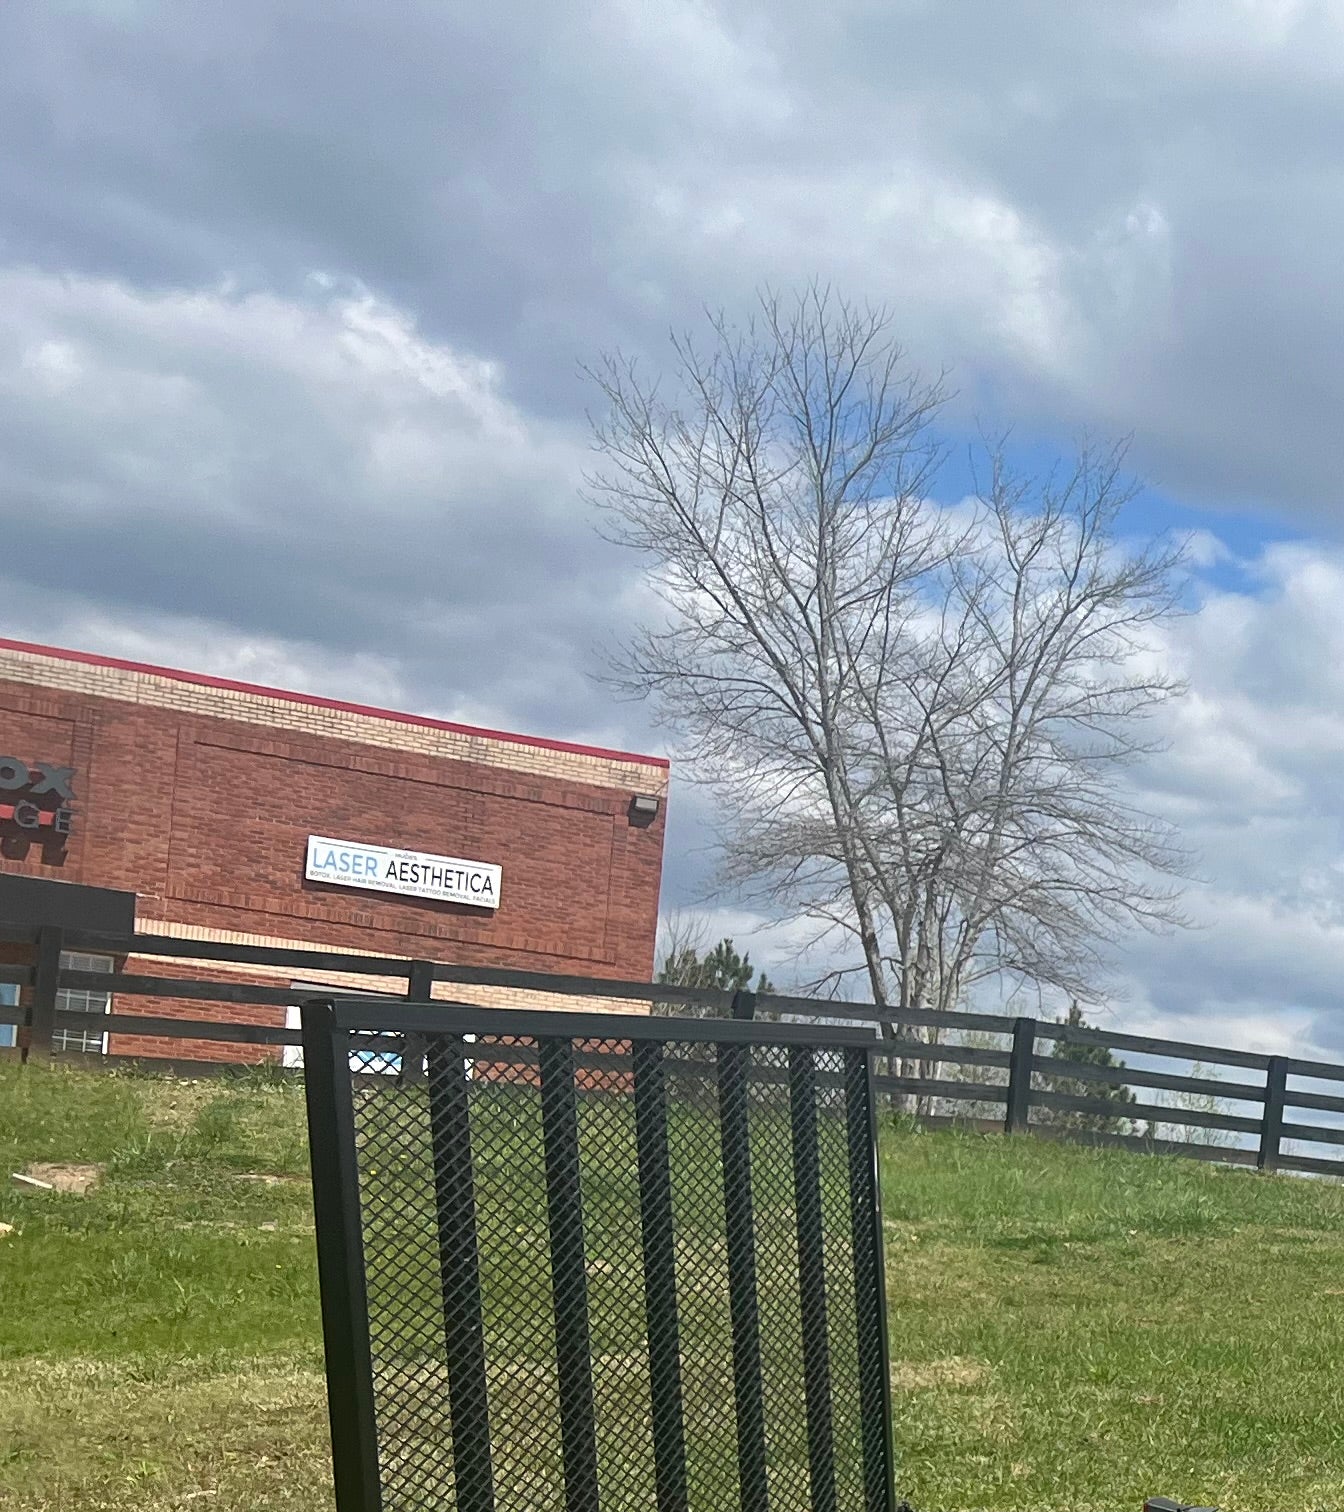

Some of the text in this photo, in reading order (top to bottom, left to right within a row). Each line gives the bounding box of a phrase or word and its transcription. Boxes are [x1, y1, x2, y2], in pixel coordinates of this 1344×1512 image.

[312, 847, 494, 895] LASER AESTHETICA
[399, 884, 417, 892] LASER
